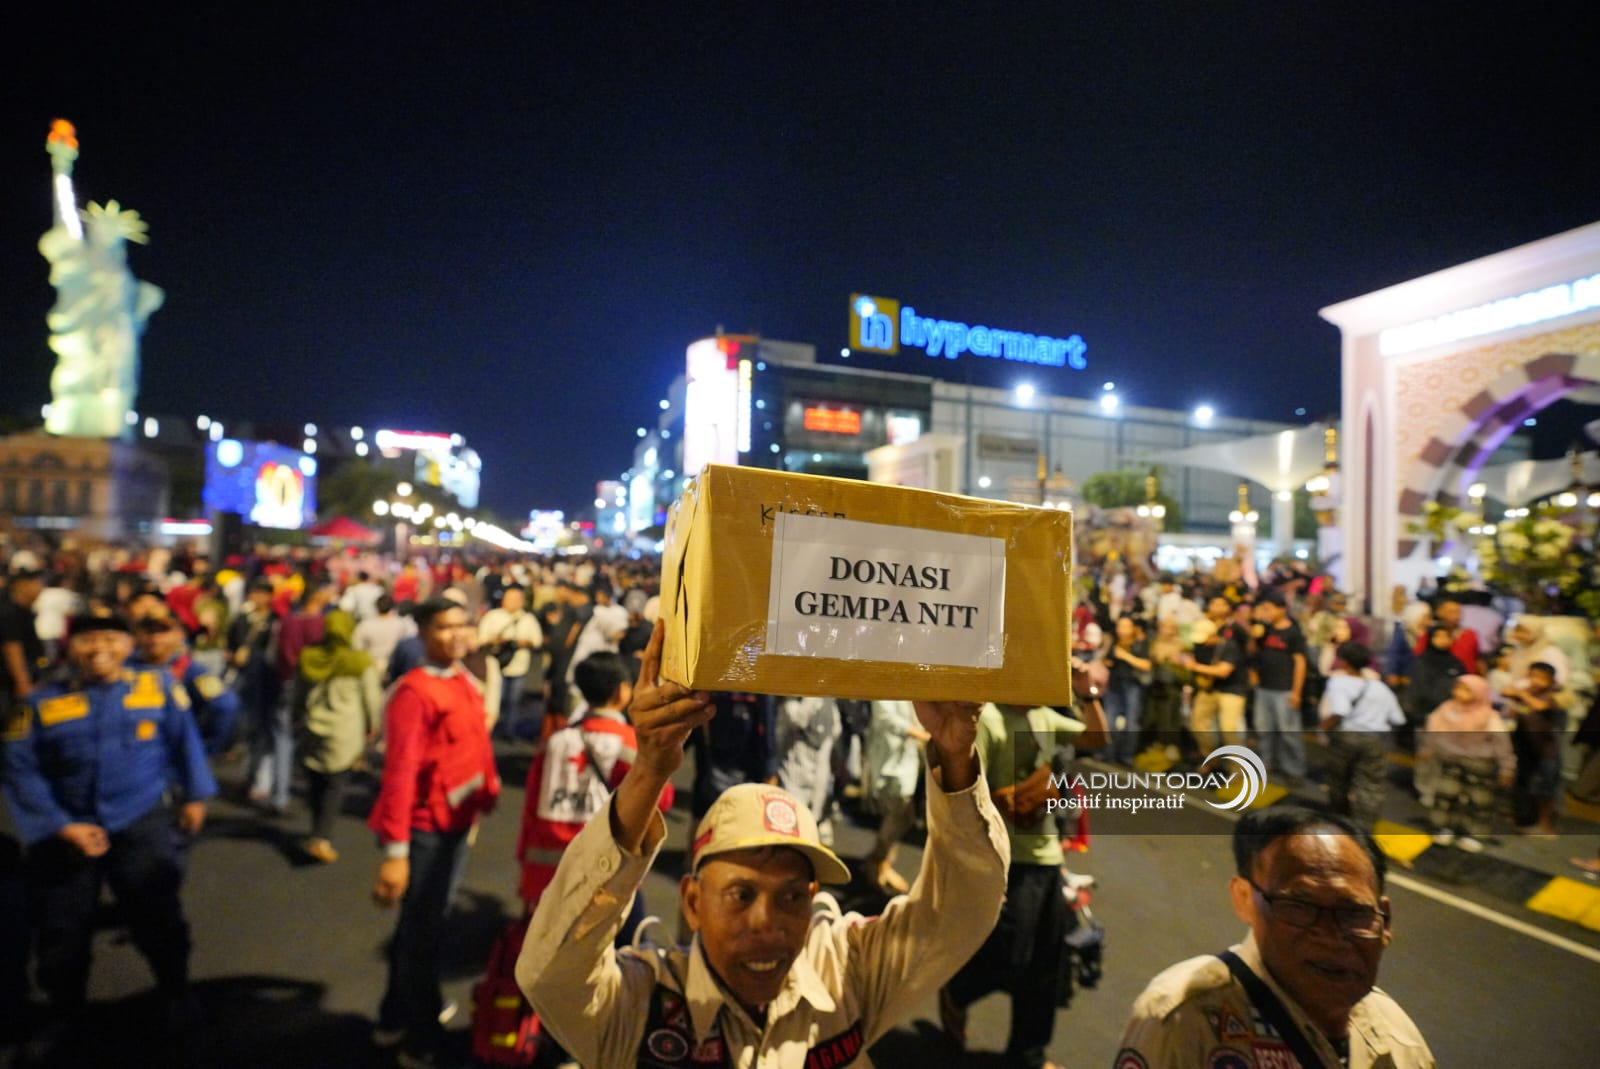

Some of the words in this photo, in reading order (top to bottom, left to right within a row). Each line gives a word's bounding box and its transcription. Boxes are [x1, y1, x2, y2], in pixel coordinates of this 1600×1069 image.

[900, 306, 1088, 370] hypermart
[829, 556, 951, 591] DONASI
[794, 591, 911, 624] GEMPA
[918, 602, 979, 629] NTT
